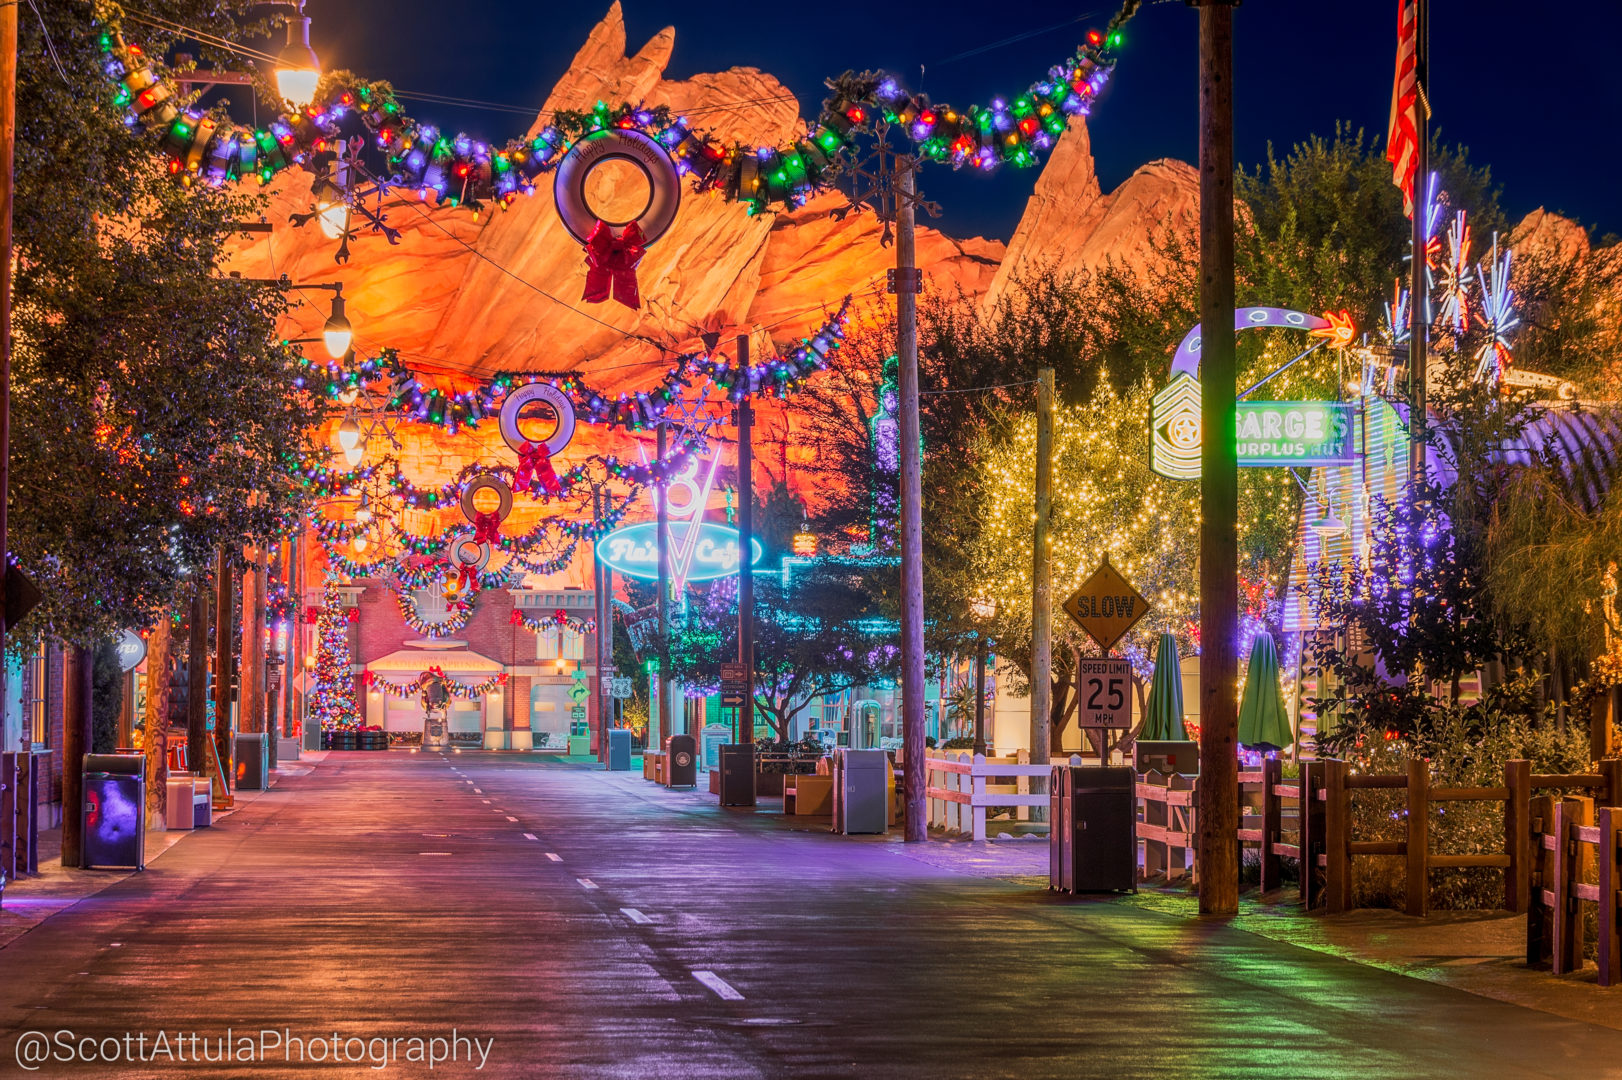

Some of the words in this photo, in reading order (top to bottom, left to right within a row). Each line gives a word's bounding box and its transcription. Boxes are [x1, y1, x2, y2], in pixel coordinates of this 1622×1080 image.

[571, 140, 605, 163] Happy
[618, 131, 657, 164] Holidays
[1235, 410, 1348, 439] ARGE'S
[1236, 442, 1306, 457] URPLUS
[1311, 443, 1344, 457] HUT
[695, 538, 740, 570] Caf
[1077, 596, 1135, 618] SLOW
[1082, 663, 1107, 674] SPEED
[1108, 663, 1130, 674] LIMIT
[1087, 678, 1124, 711] 25
[1095, 713, 1114, 724] MPH
